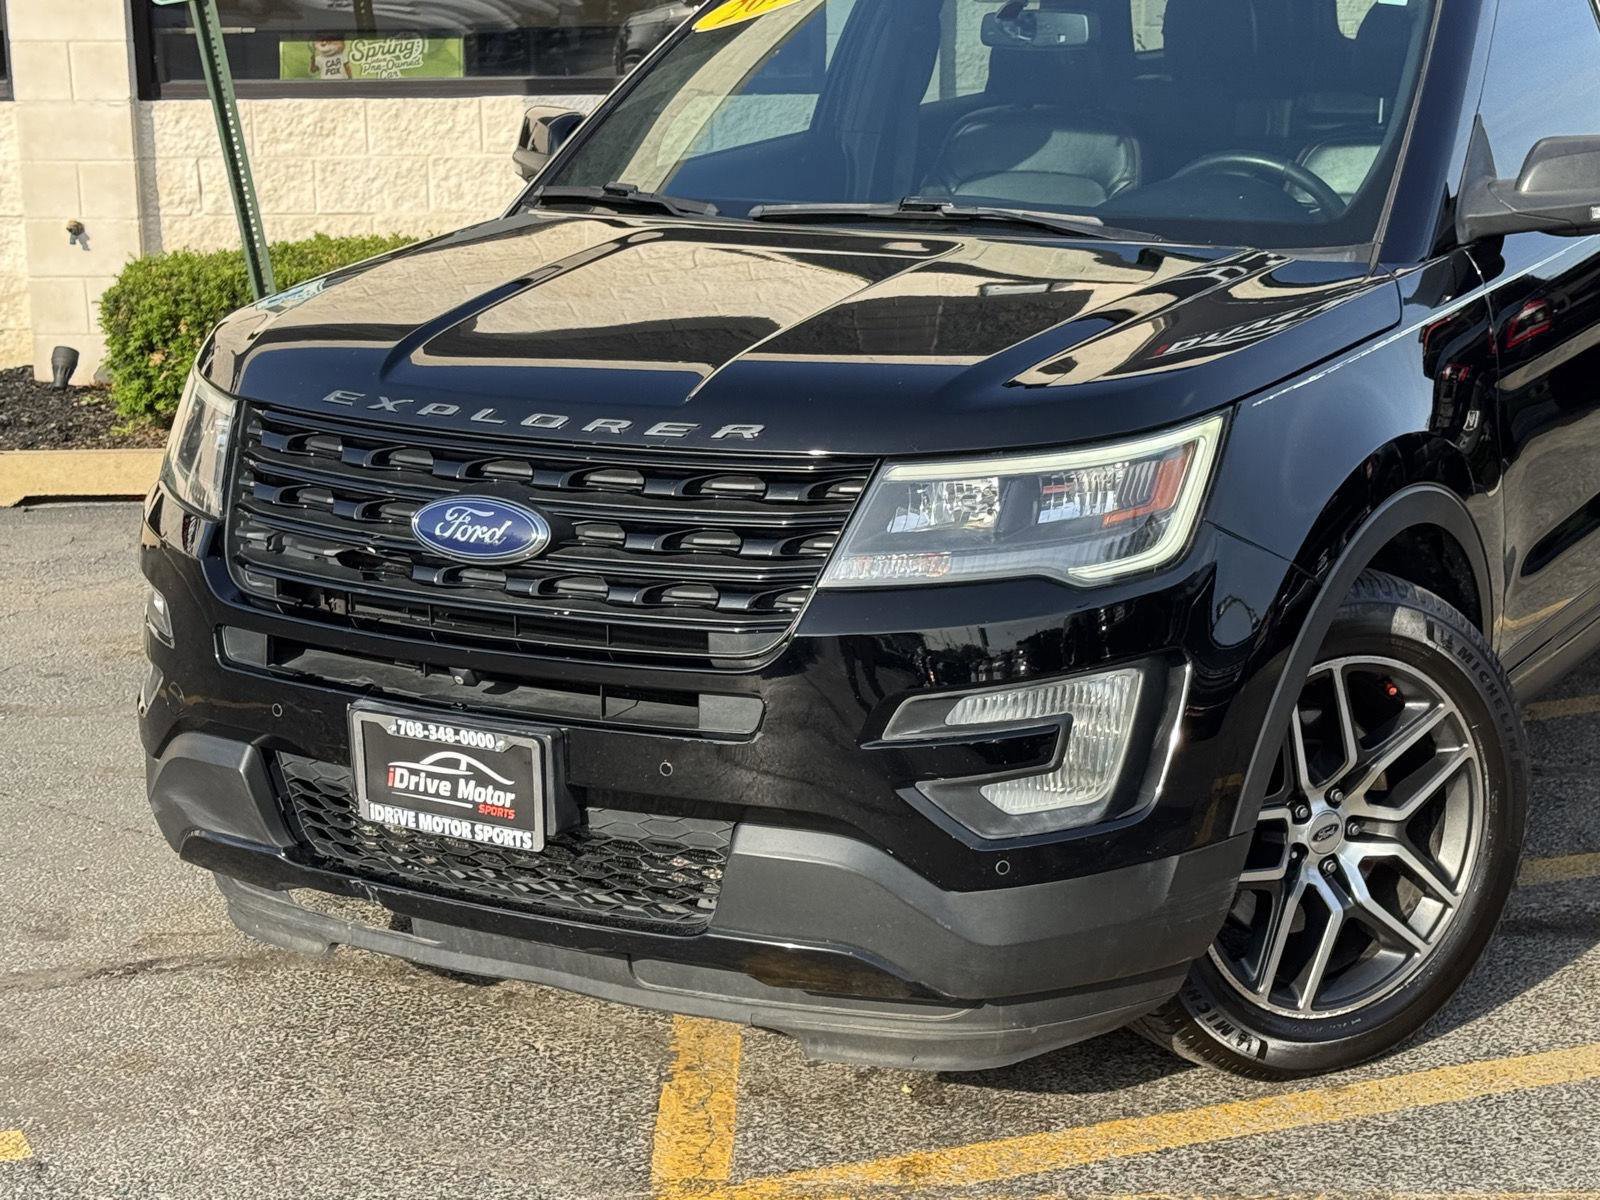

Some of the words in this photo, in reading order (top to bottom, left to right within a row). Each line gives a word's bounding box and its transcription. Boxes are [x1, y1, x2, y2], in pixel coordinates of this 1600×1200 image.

[351, 38, 417, 62] Spring
[325, 67, 341, 76] FOX
[326, 58, 341, 68] CAR
[363, 57, 422, 72] Pre-Owned
[380, 69, 400, 79] Car
[322, 389, 767, 440] EXPLORER
[434, 506, 513, 545] Ford
[397, 719, 495, 749] 708-348-0000
[387, 765, 452, 797] iDrive
[457, 778, 516, 808] Motor
[478, 803, 516, 821] SPORTS
[419, 814, 473, 839] MOTOR
[474, 824, 533, 849] SPORTS
